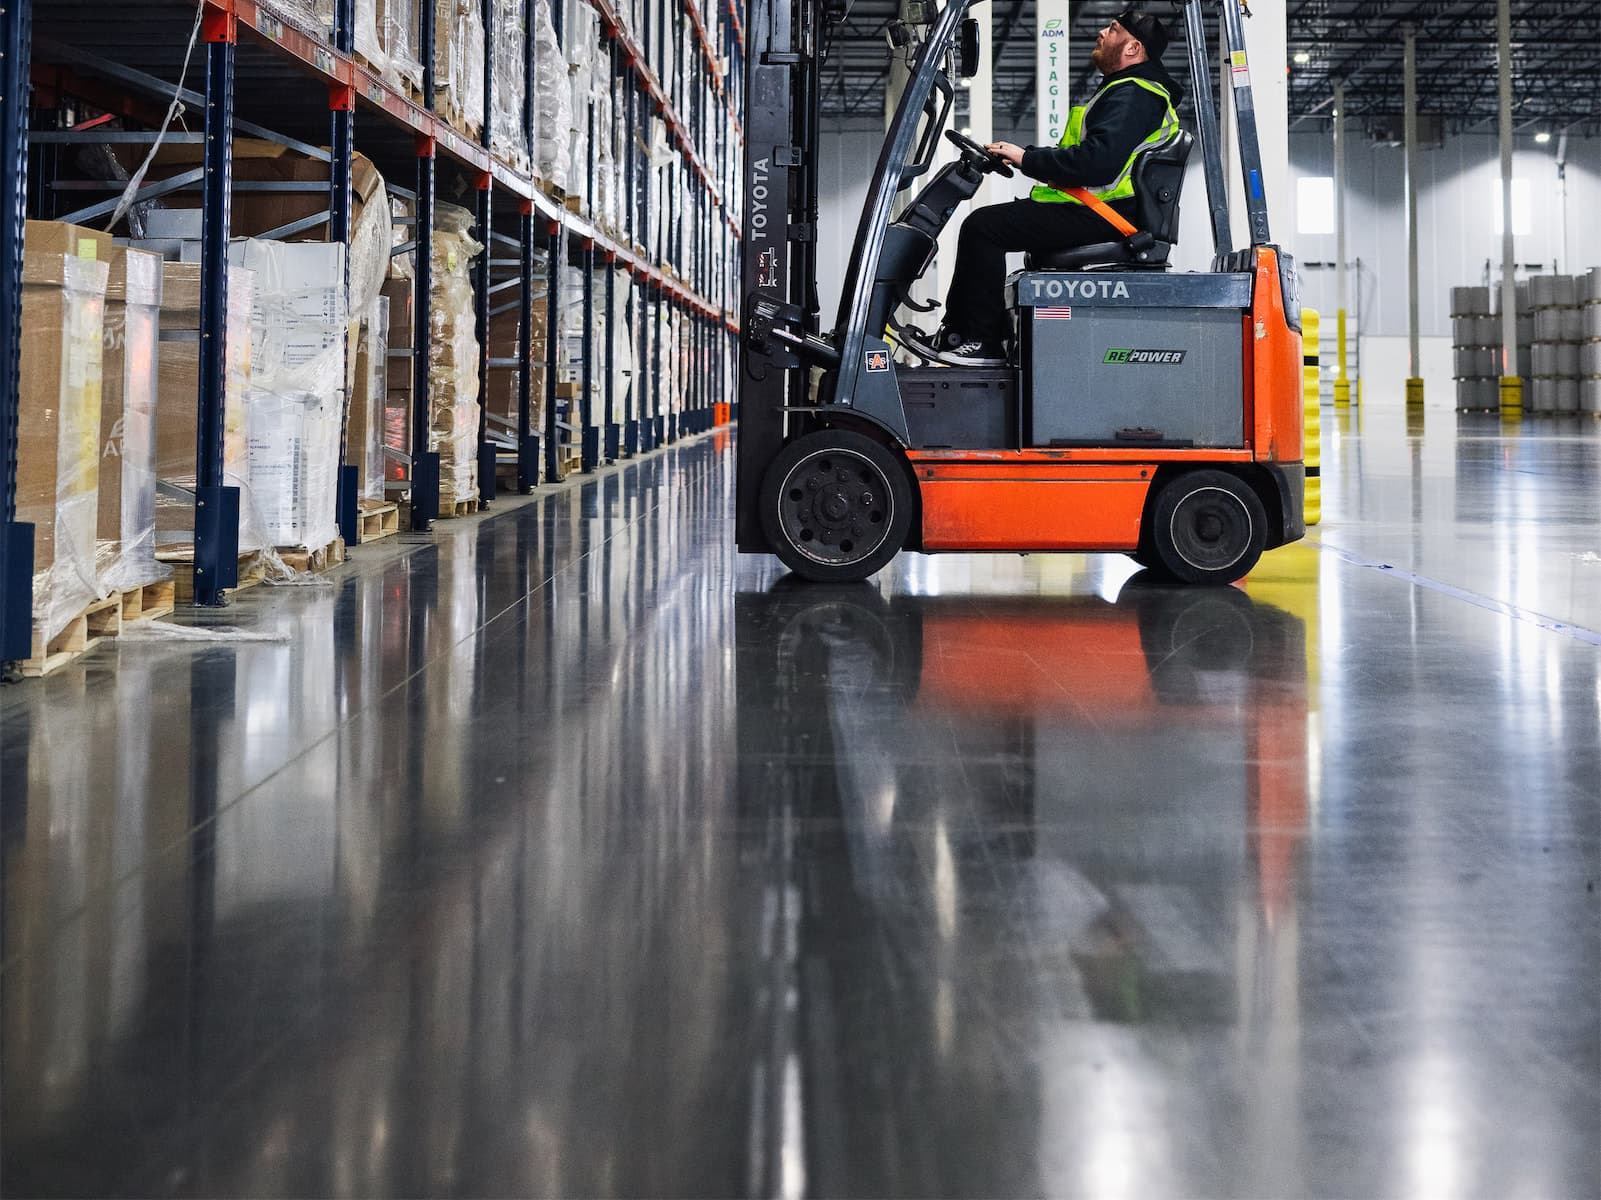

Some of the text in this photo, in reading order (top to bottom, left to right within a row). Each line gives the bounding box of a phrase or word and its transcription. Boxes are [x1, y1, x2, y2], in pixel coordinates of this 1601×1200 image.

[1041, 29, 1064, 37] ADM
[1049, 42, 1059, 138] STAGING
[751, 157, 769, 241] TOYOTA
[1031, 280, 1130, 299] TOYOTA
